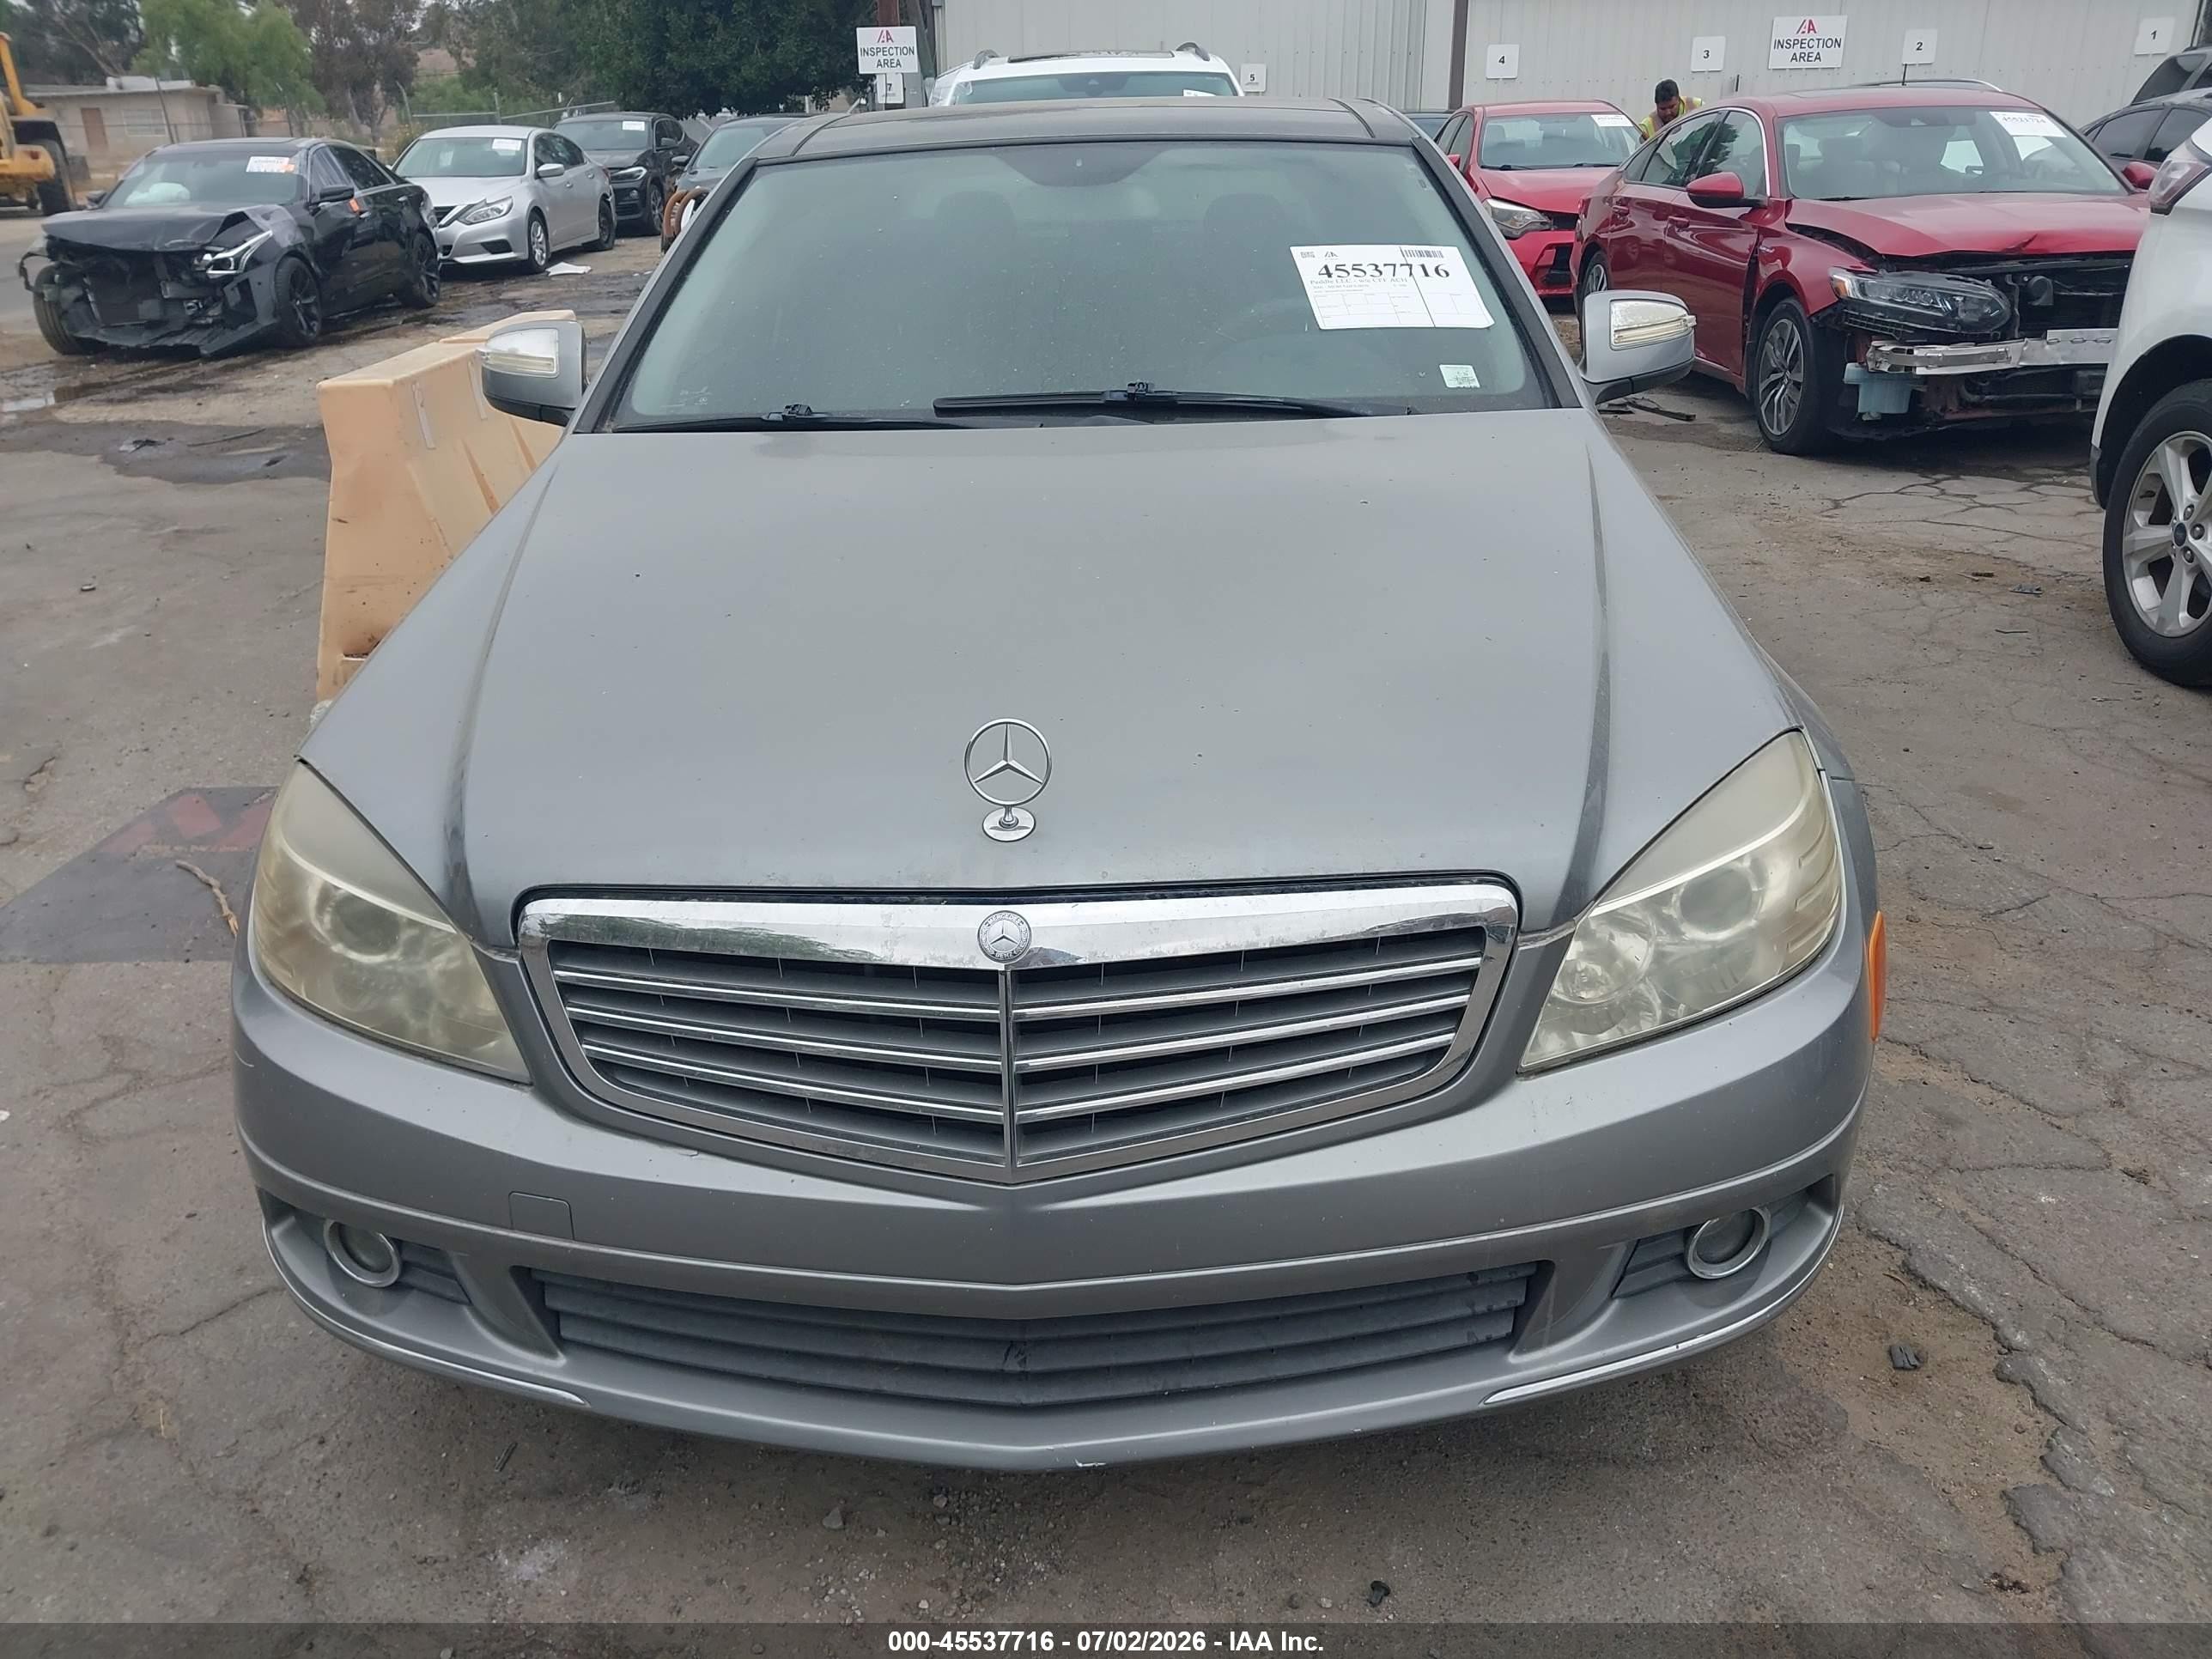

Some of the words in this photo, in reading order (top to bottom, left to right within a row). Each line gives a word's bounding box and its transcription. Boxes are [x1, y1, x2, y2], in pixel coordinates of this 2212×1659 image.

[2150, 29, 2157, 40] 1
[1773, 37, 1842, 50] INSPECTION
[1916, 41, 1923, 51] 2
[860, 46, 915, 57] INSPECTION
[1703, 49, 1710, 59] 3
[1498, 55, 1505, 64] 4
[1790, 52, 1822, 63] AREA
[876, 59, 902, 69] AREA
[1249, 73, 1255, 82] 5
[887, 82, 893, 92] 7
[1317, 263, 1450, 278] 45537716
